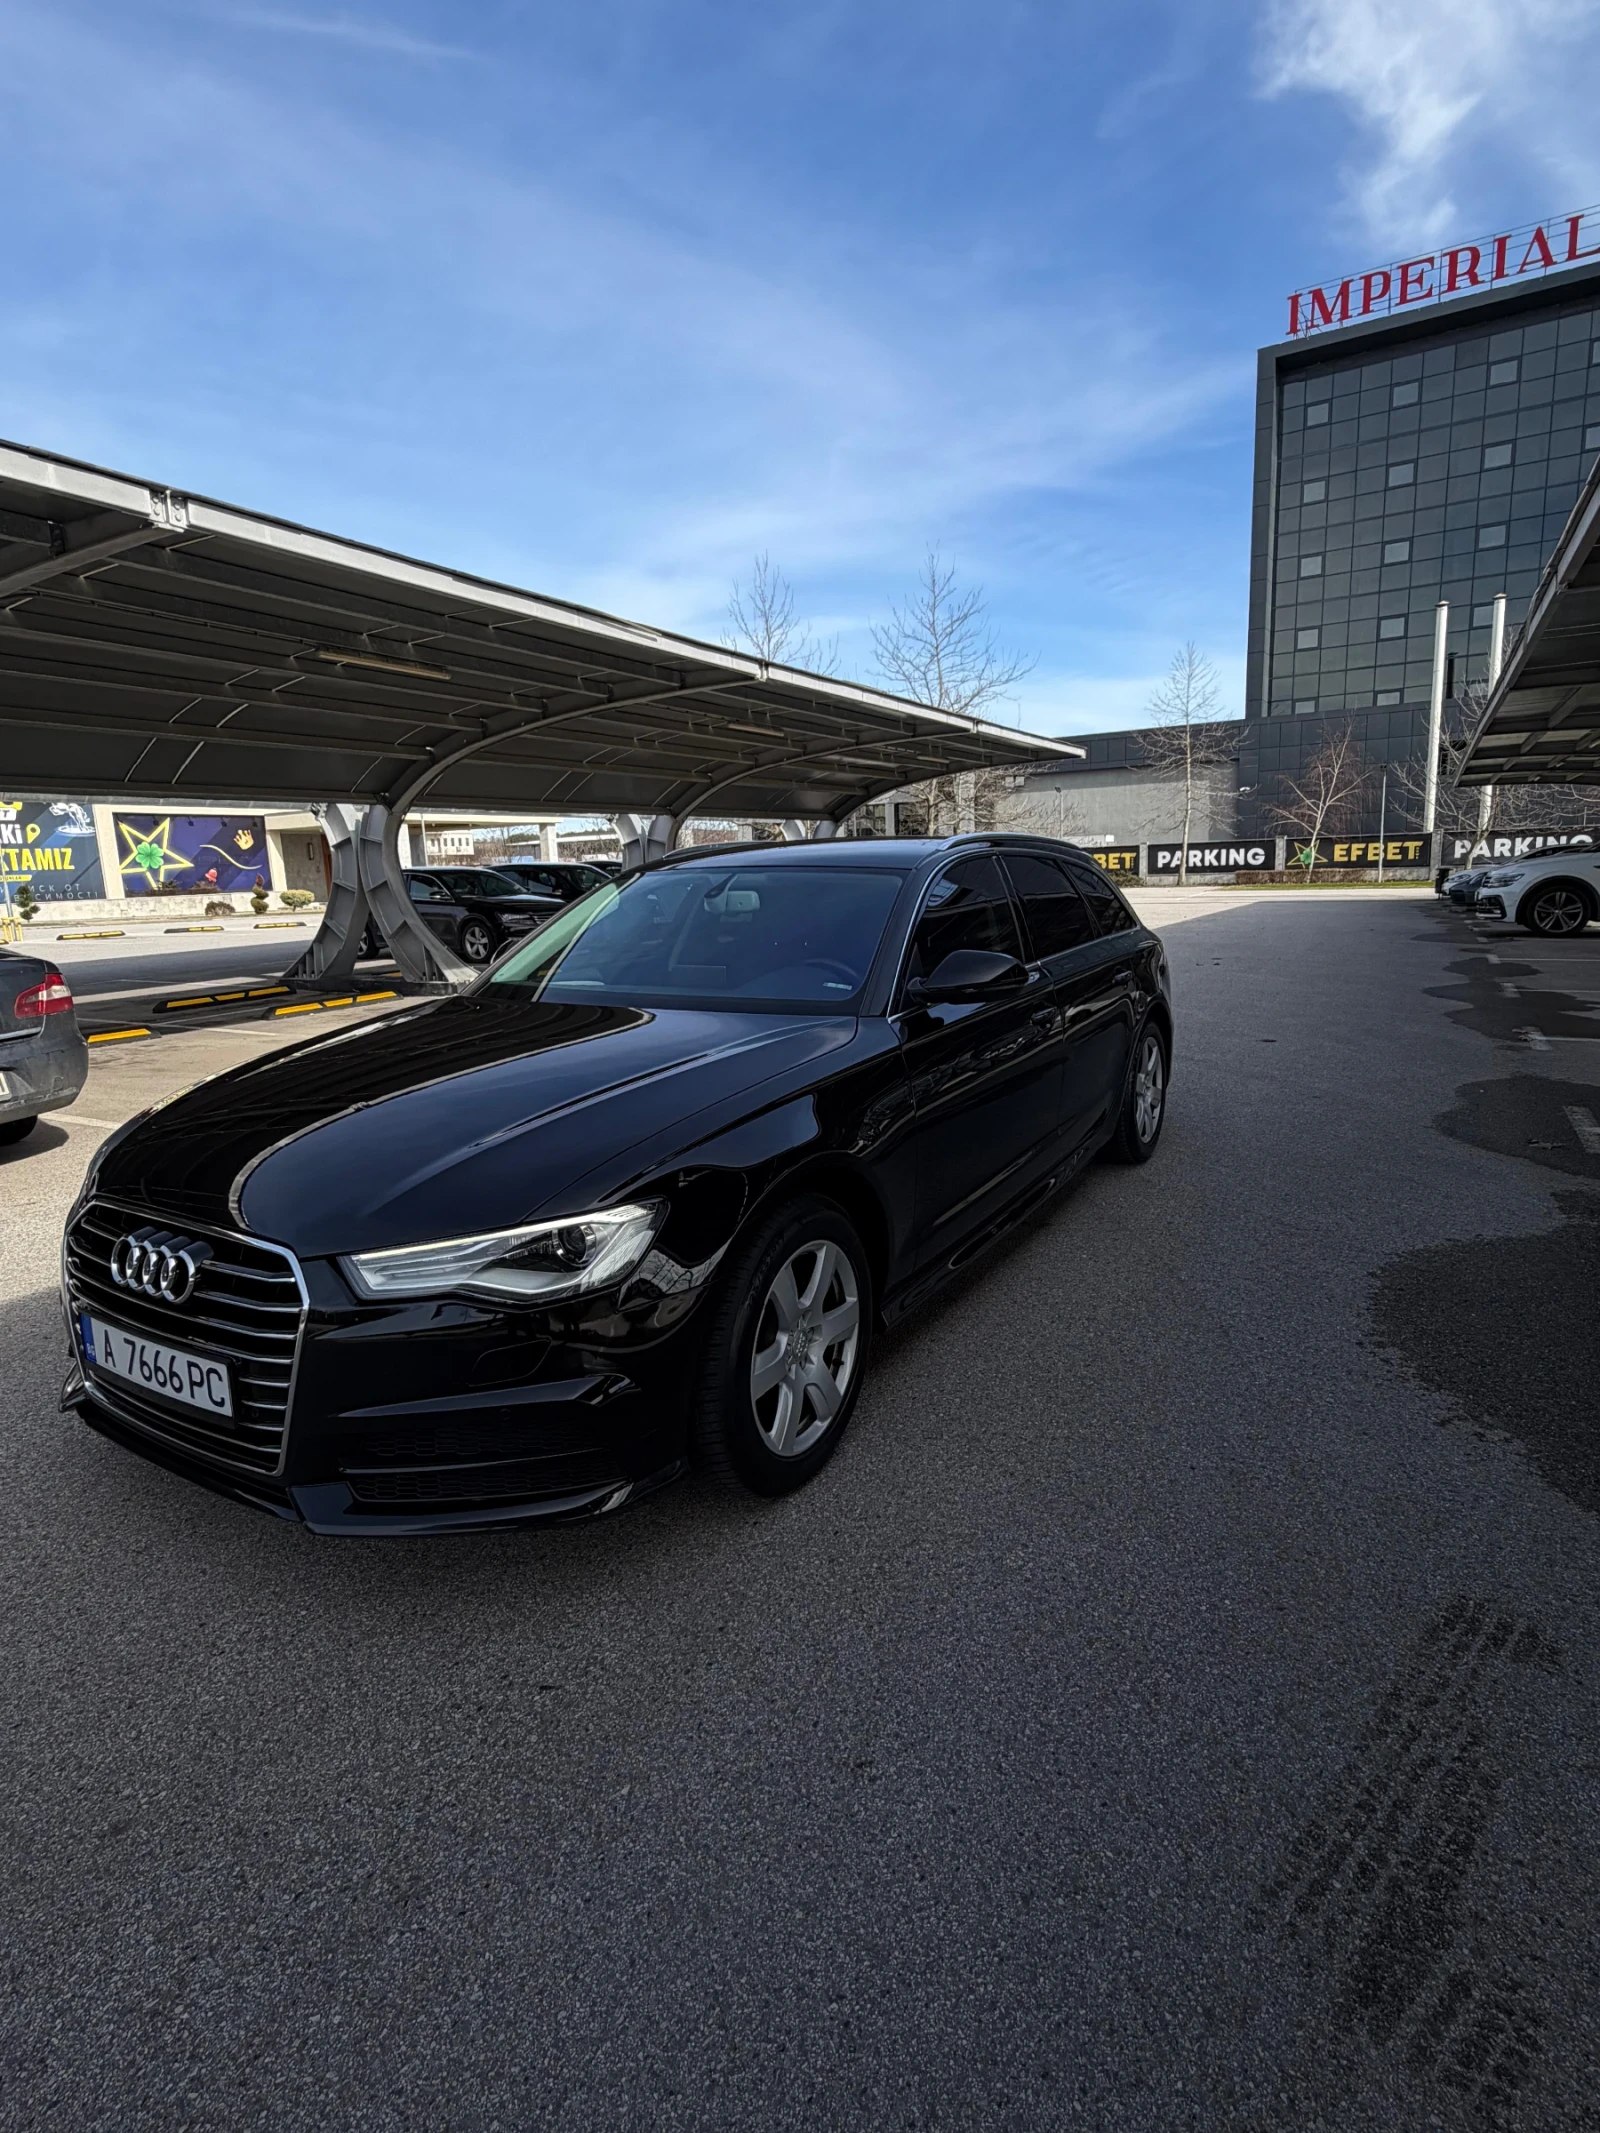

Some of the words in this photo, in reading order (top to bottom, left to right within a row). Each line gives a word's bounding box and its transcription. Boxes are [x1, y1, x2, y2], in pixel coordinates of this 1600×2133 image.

[1285, 214, 1600, 336] IMPERIAL
[1092, 852, 1137, 869] BET
[1157, 847, 1266, 868] PARKING
[1333, 841, 1424, 862] EFBET
